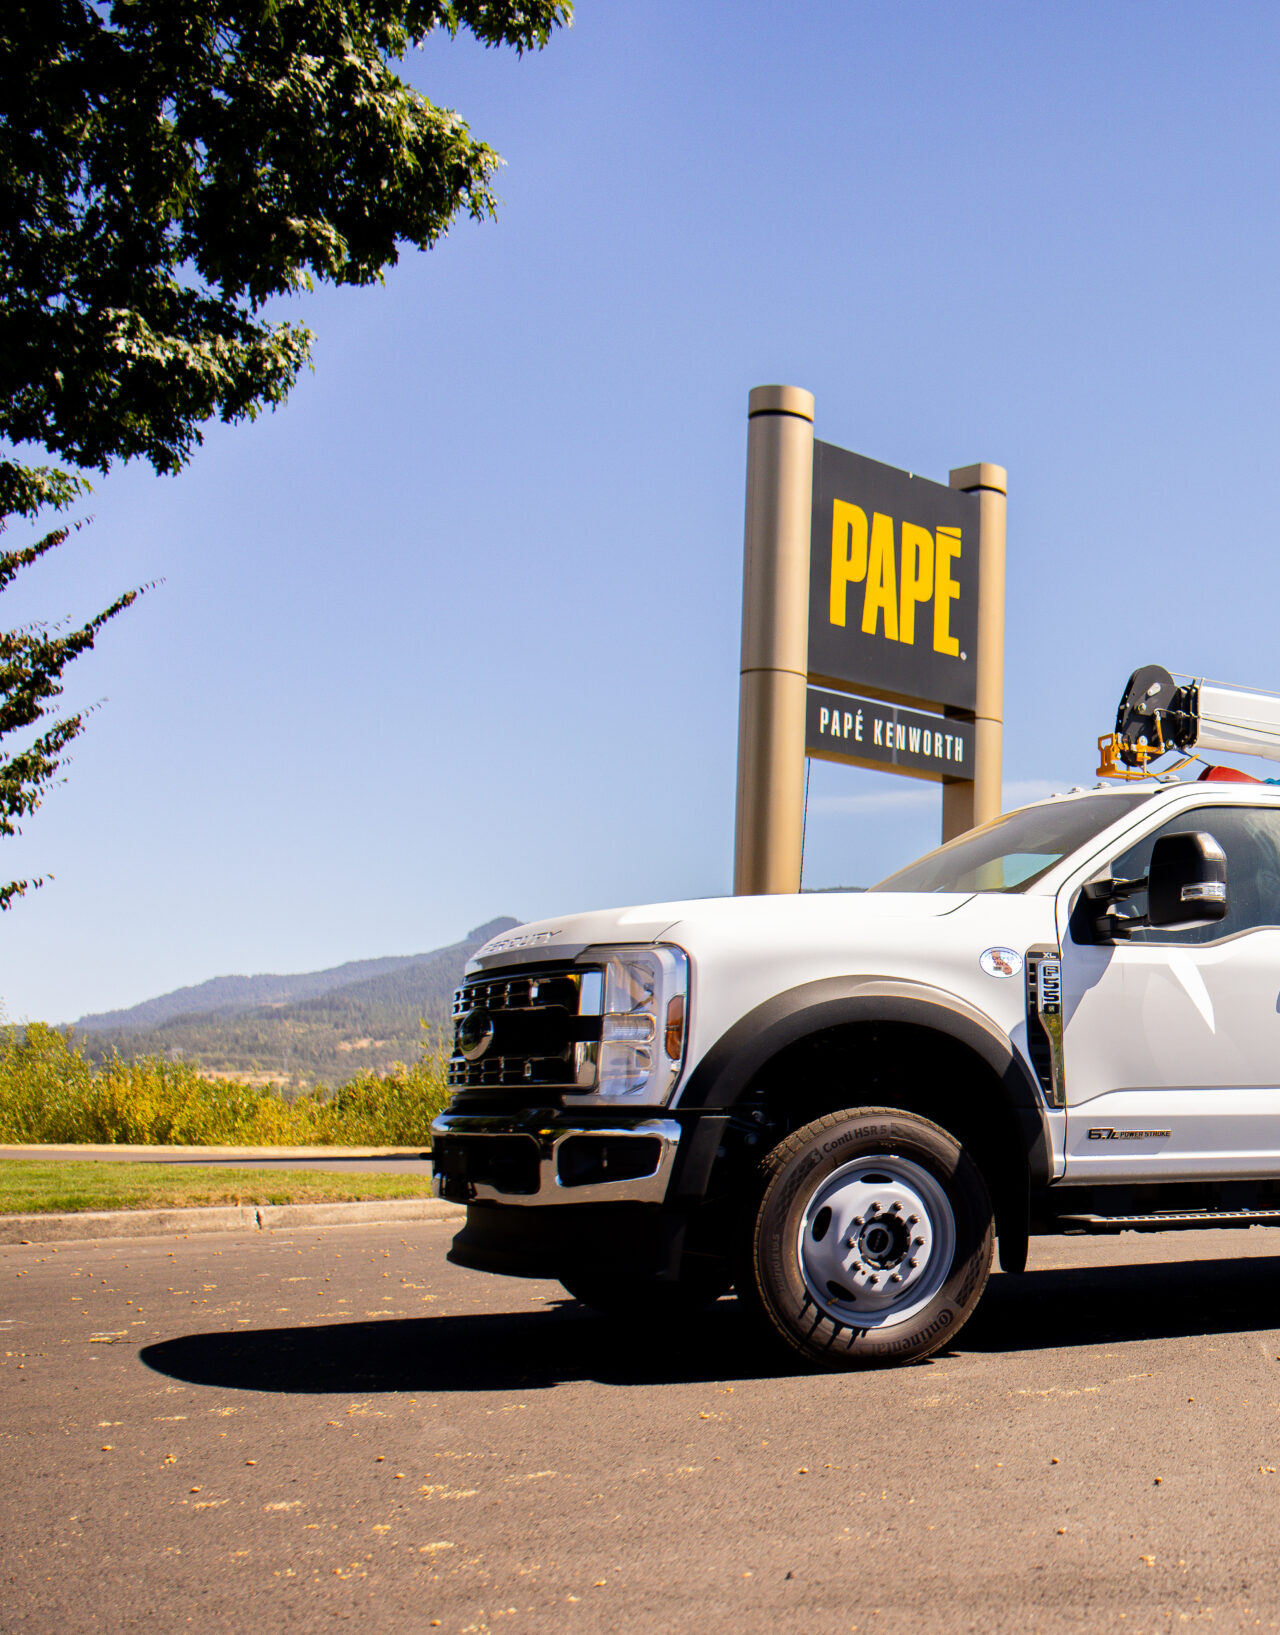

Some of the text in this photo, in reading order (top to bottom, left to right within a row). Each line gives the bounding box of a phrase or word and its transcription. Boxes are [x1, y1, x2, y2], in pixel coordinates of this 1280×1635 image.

[829, 498, 962, 657] PAPÉ
[819, 706, 964, 763] PAPÉ KENWORTH
[1043, 951, 1057, 959] XL
[823, 1124, 888, 1153] Conti HSR 5
[871, 1308, 954, 1357] Continental
